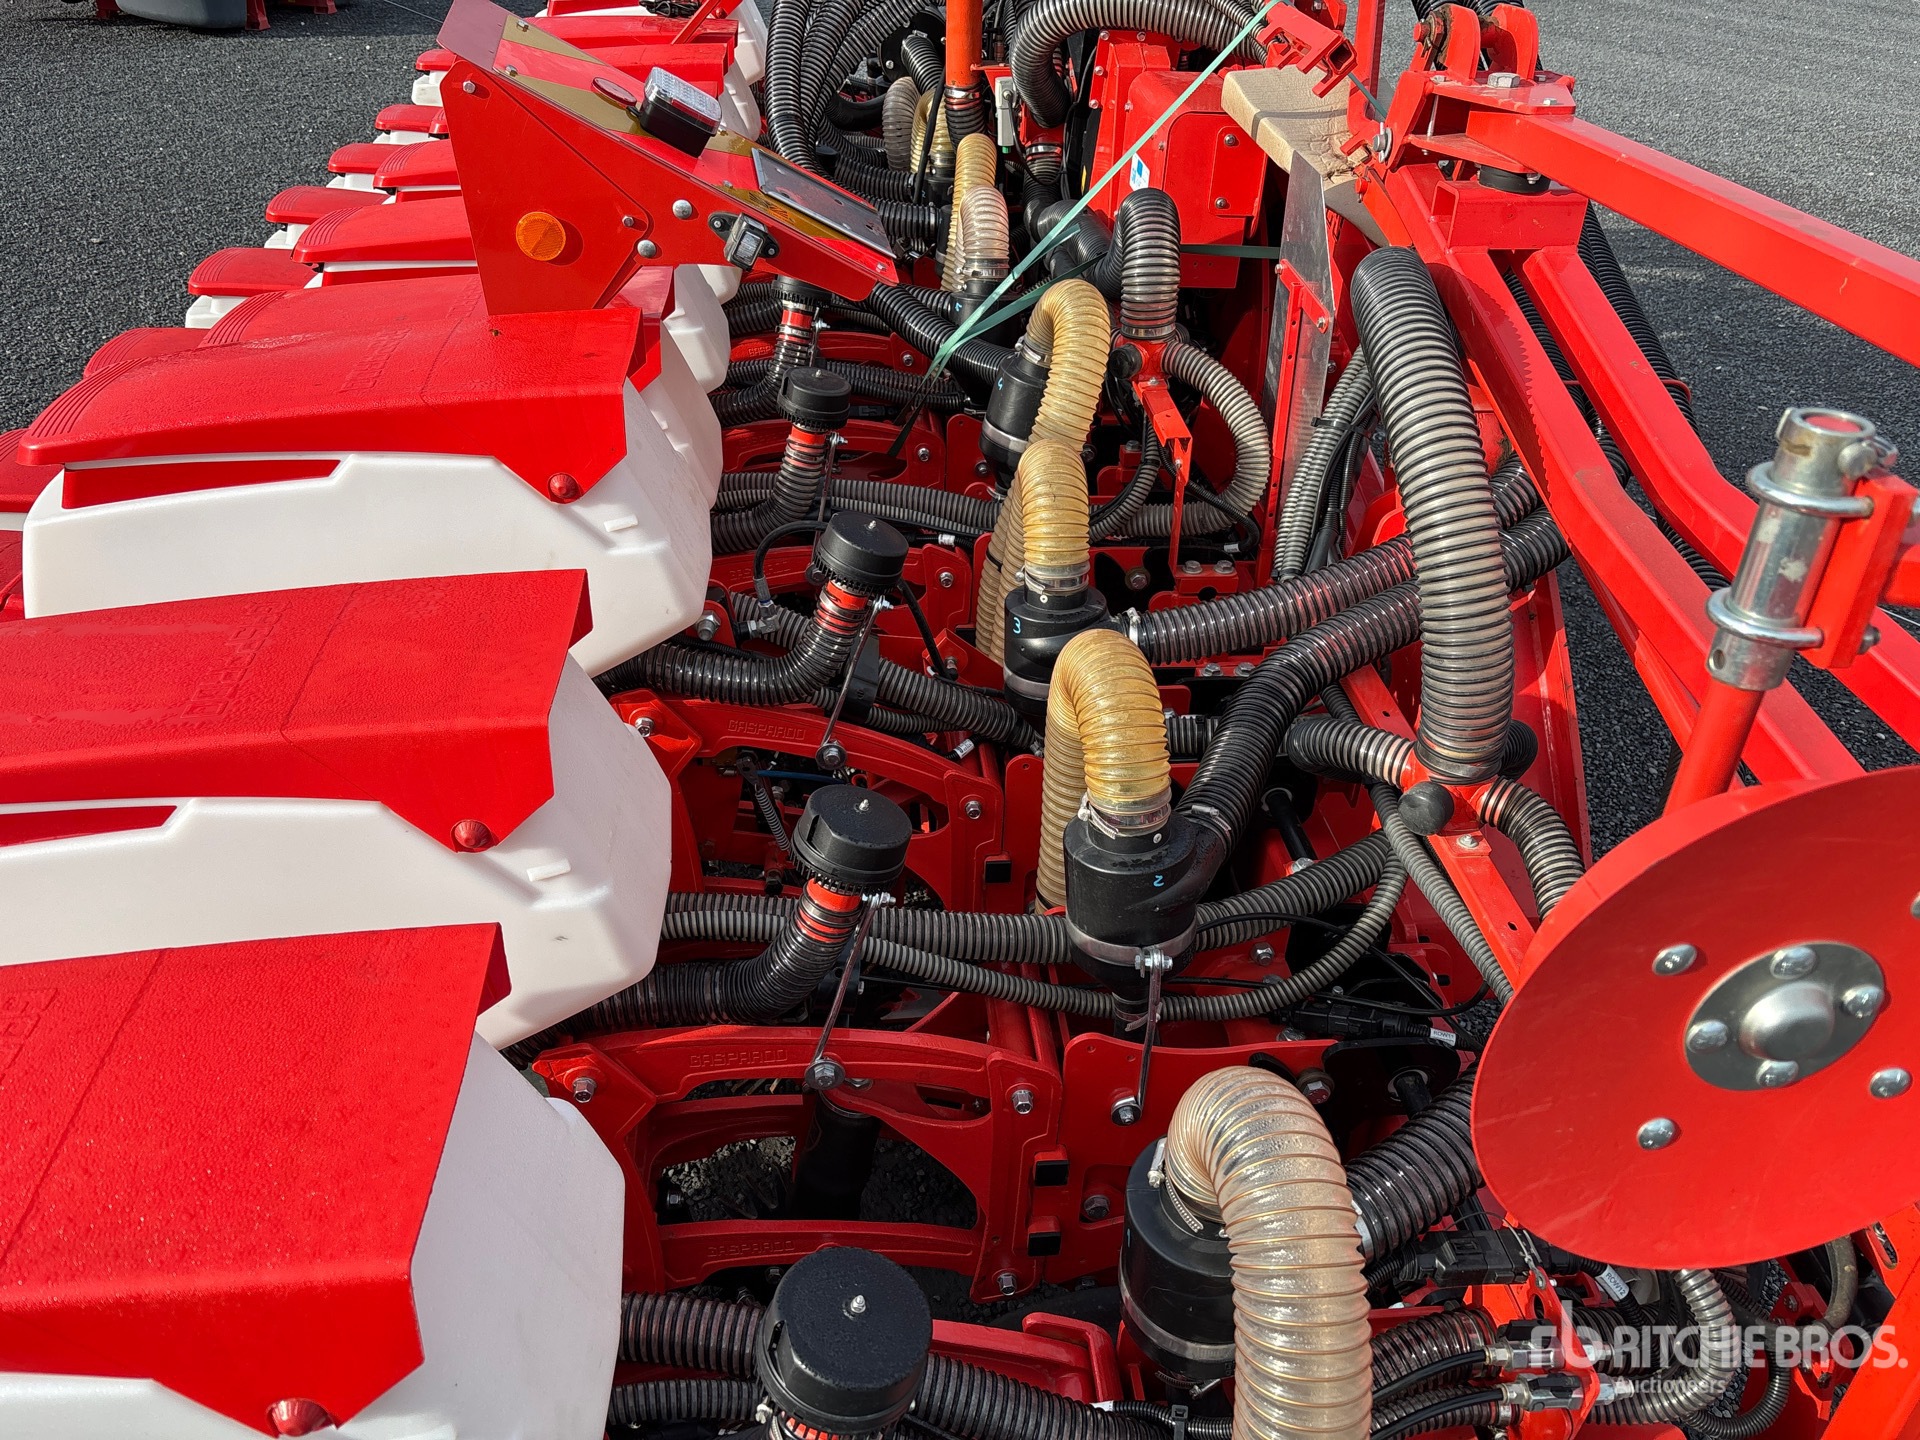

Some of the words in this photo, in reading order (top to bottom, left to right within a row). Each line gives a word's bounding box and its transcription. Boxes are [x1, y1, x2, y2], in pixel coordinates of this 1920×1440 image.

[1012, 616, 1022, 634] 3
[727, 719, 807, 741] GASPARDO
[1153, 874, 1165, 887] 2
[689, 1049, 788, 1068] GASPARDO
[706, 1240, 796, 1257] GASPARDO
[1605, 1272, 1627, 1297] ROW12
